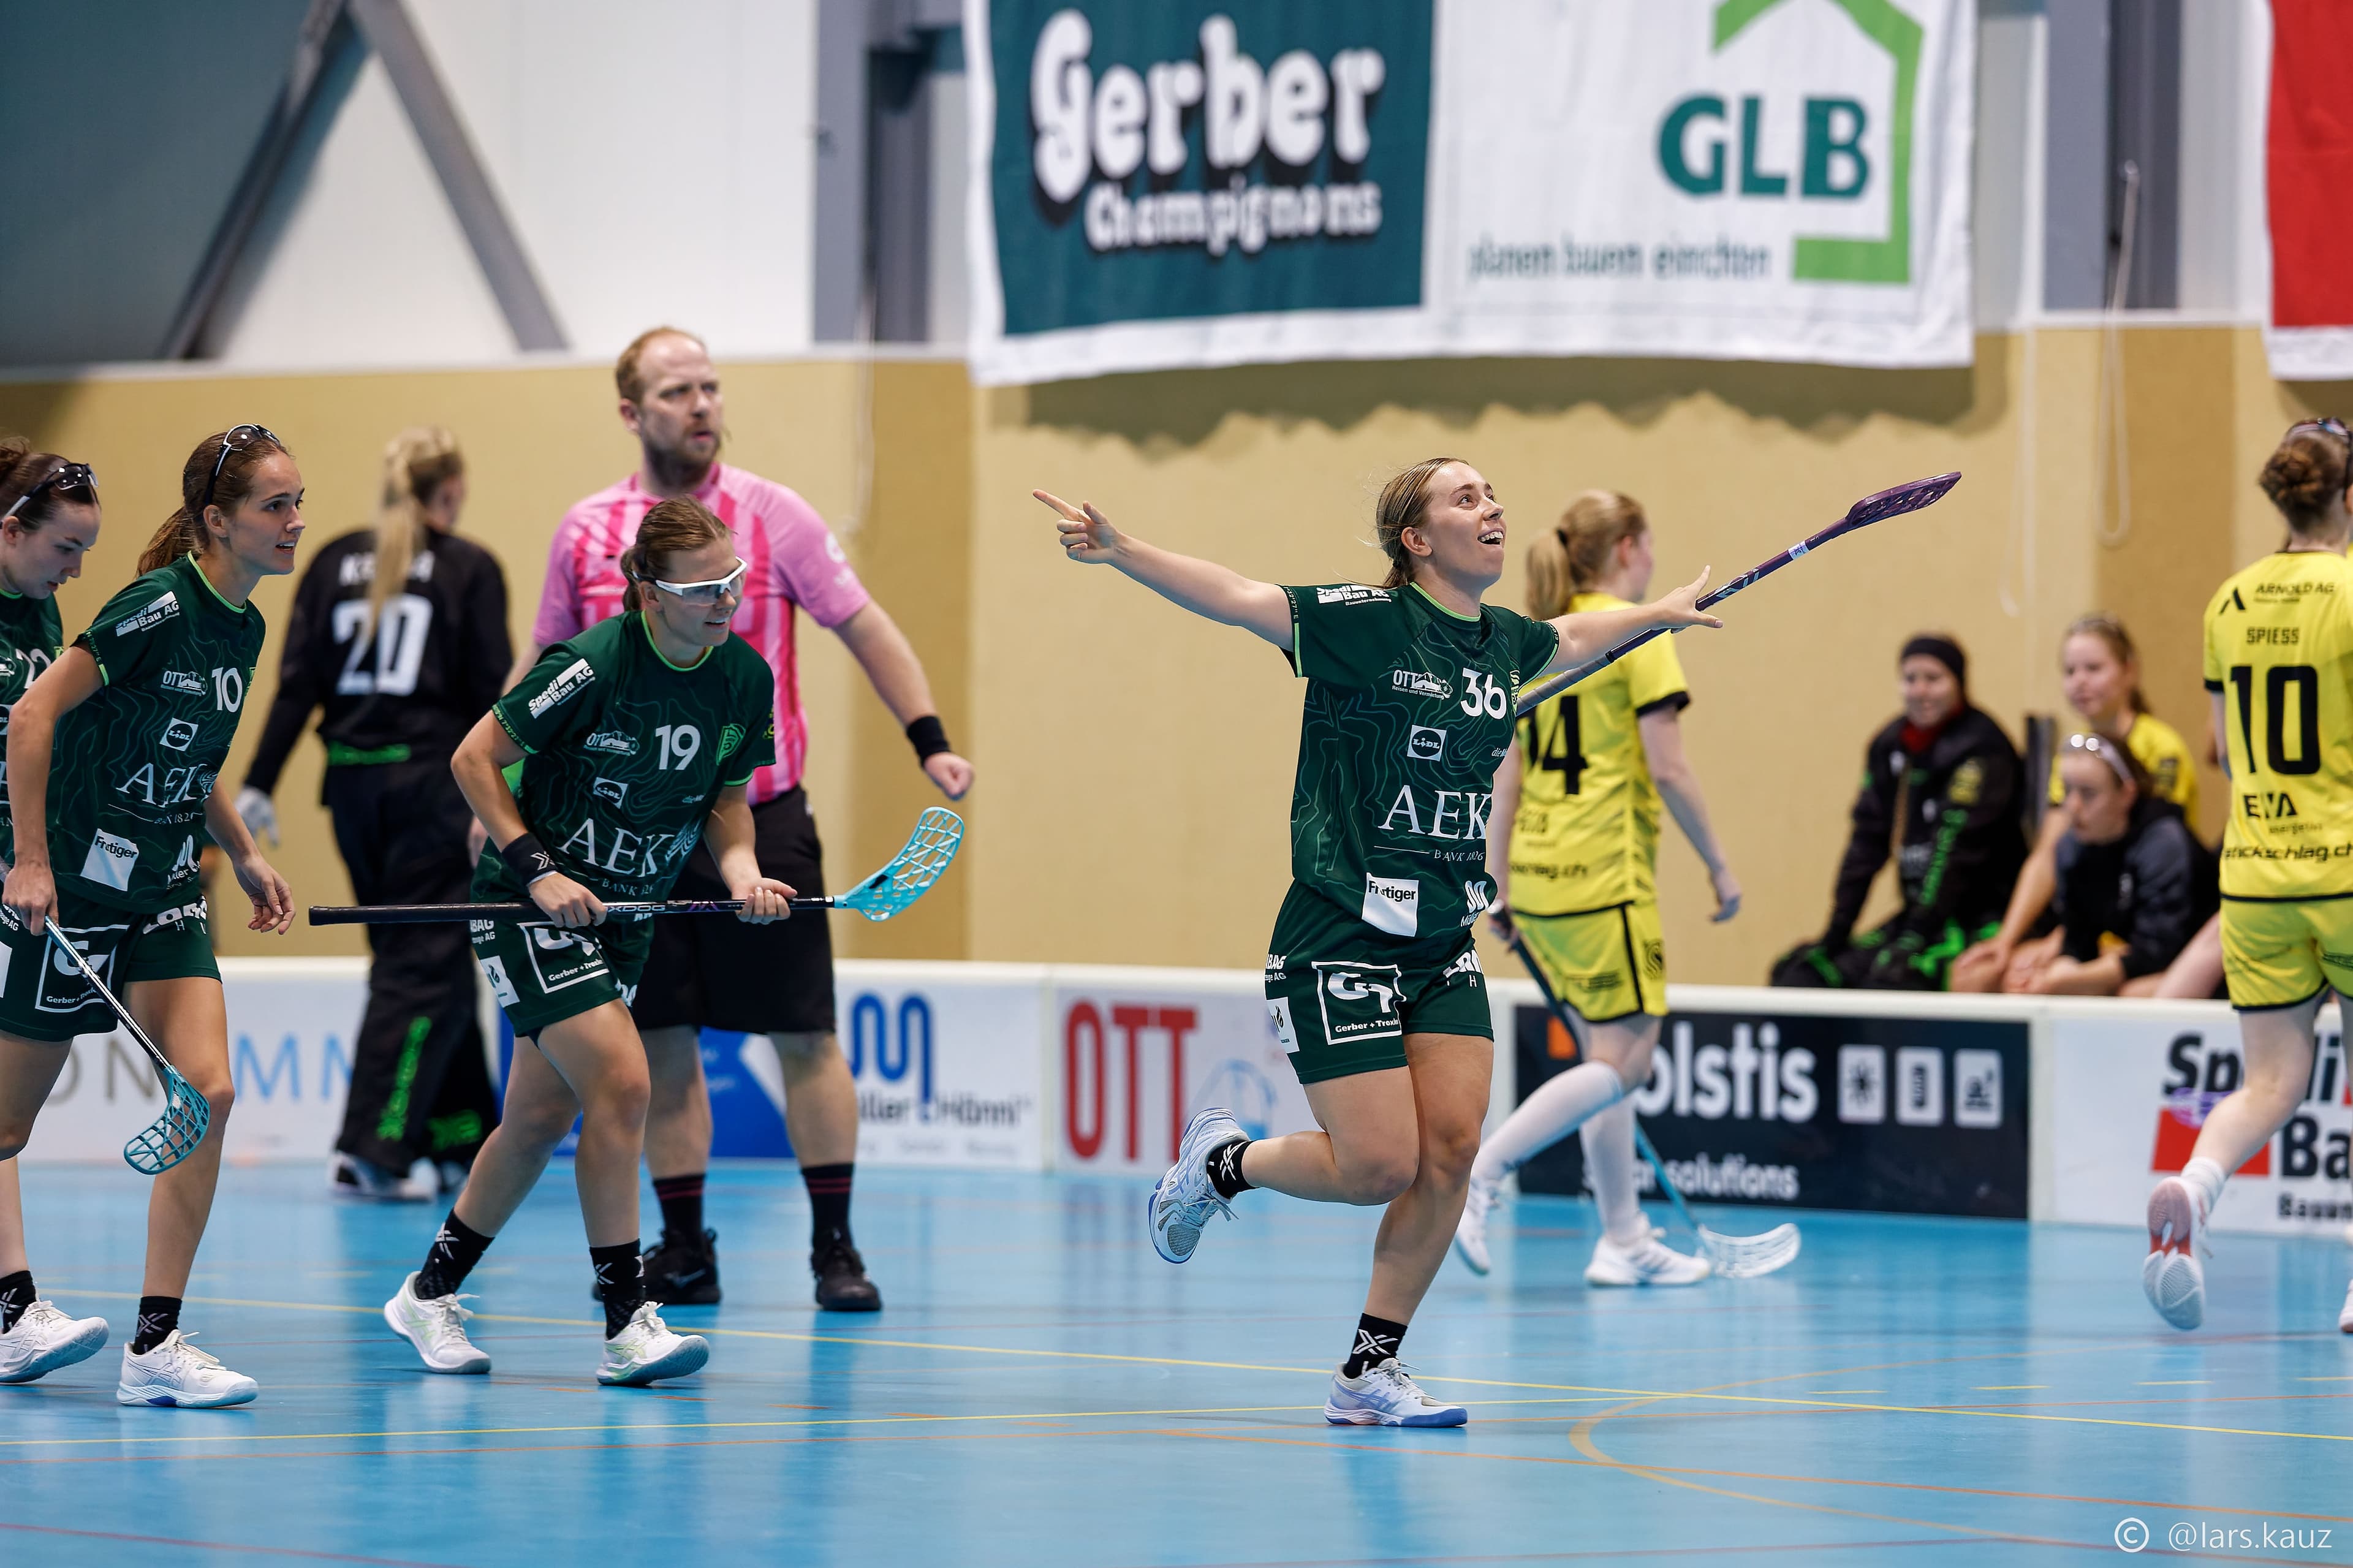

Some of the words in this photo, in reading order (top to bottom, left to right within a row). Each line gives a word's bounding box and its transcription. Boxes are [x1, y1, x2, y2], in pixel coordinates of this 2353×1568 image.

[1031, 9, 1386, 203] Gerber
[1657, 92, 1871, 199] GLB
[1085, 183, 1382, 256] Champignons
[137, 612, 162, 627] Bau
[164, 601, 180, 615] AG
[1344, 591, 1368, 600] Bau
[332, 593, 433, 696] 20
[2246, 626, 2300, 645] SPIESS
[211, 667, 243, 713] 10
[528, 680, 559, 711] Spedi
[551, 682, 575, 702] Bau
[575, 665, 594, 684] AG
[1419, 690, 1444, 700] Vermietung
[1460, 667, 1507, 719] 36
[2230, 664, 2321, 775] 10
[655, 725, 700, 770] 19
[1377, 784, 1492, 839] AEK
[556, 817, 675, 877] AEK
[1434, 849, 1464, 862] BANK
[548, 968, 578, 982] Gerber
[47, 995, 76, 1004] Gerber
[1335, 1023, 1368, 1033] Gerber
[1066, 1000, 1199, 1162] OTT
[1637, 1021, 1819, 1123] olstis
